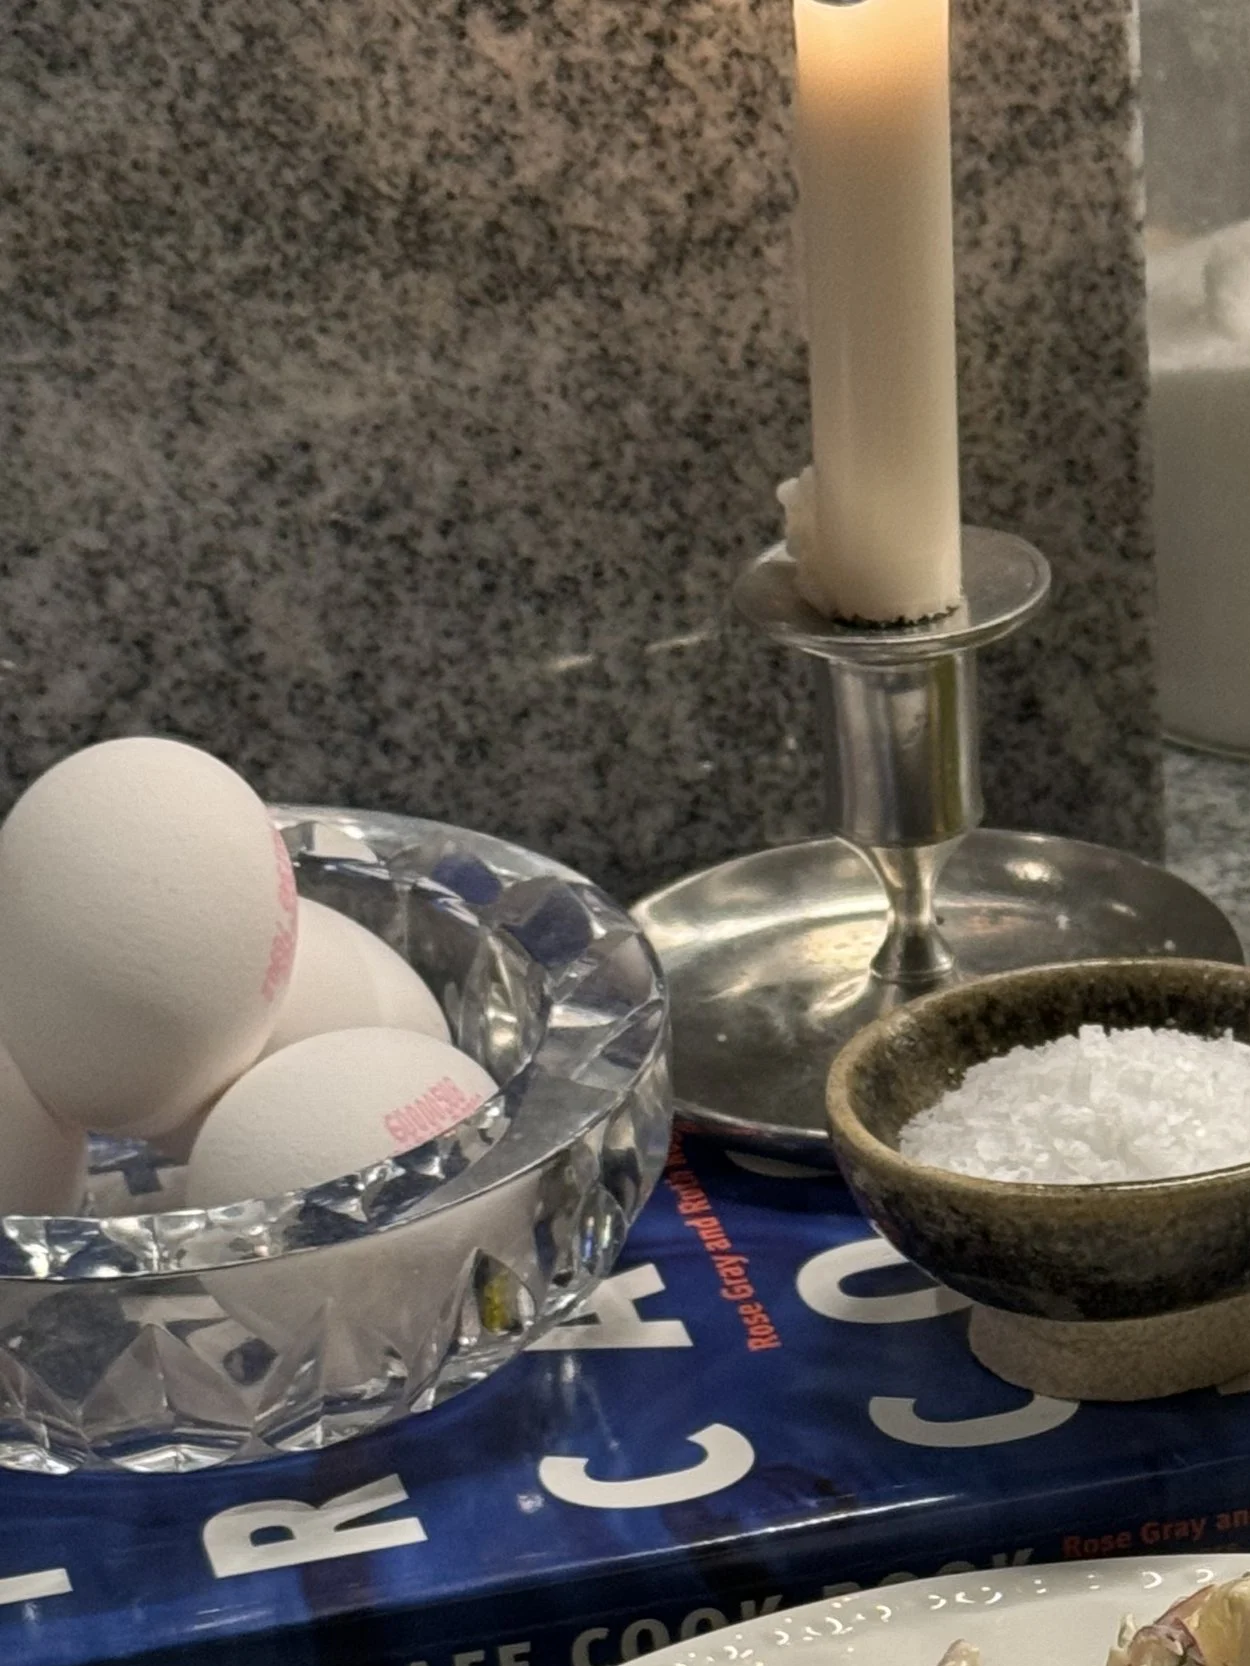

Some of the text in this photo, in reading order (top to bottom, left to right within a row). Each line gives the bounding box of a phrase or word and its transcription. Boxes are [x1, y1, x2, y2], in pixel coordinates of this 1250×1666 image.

[684, 1216, 732, 1251] and
[712, 1255, 756, 1301] Gray
[737, 1302, 782, 1352] Rose
[1062, 1529, 1132, 1558] Rose
[1140, 1516, 1206, 1545] Gray
